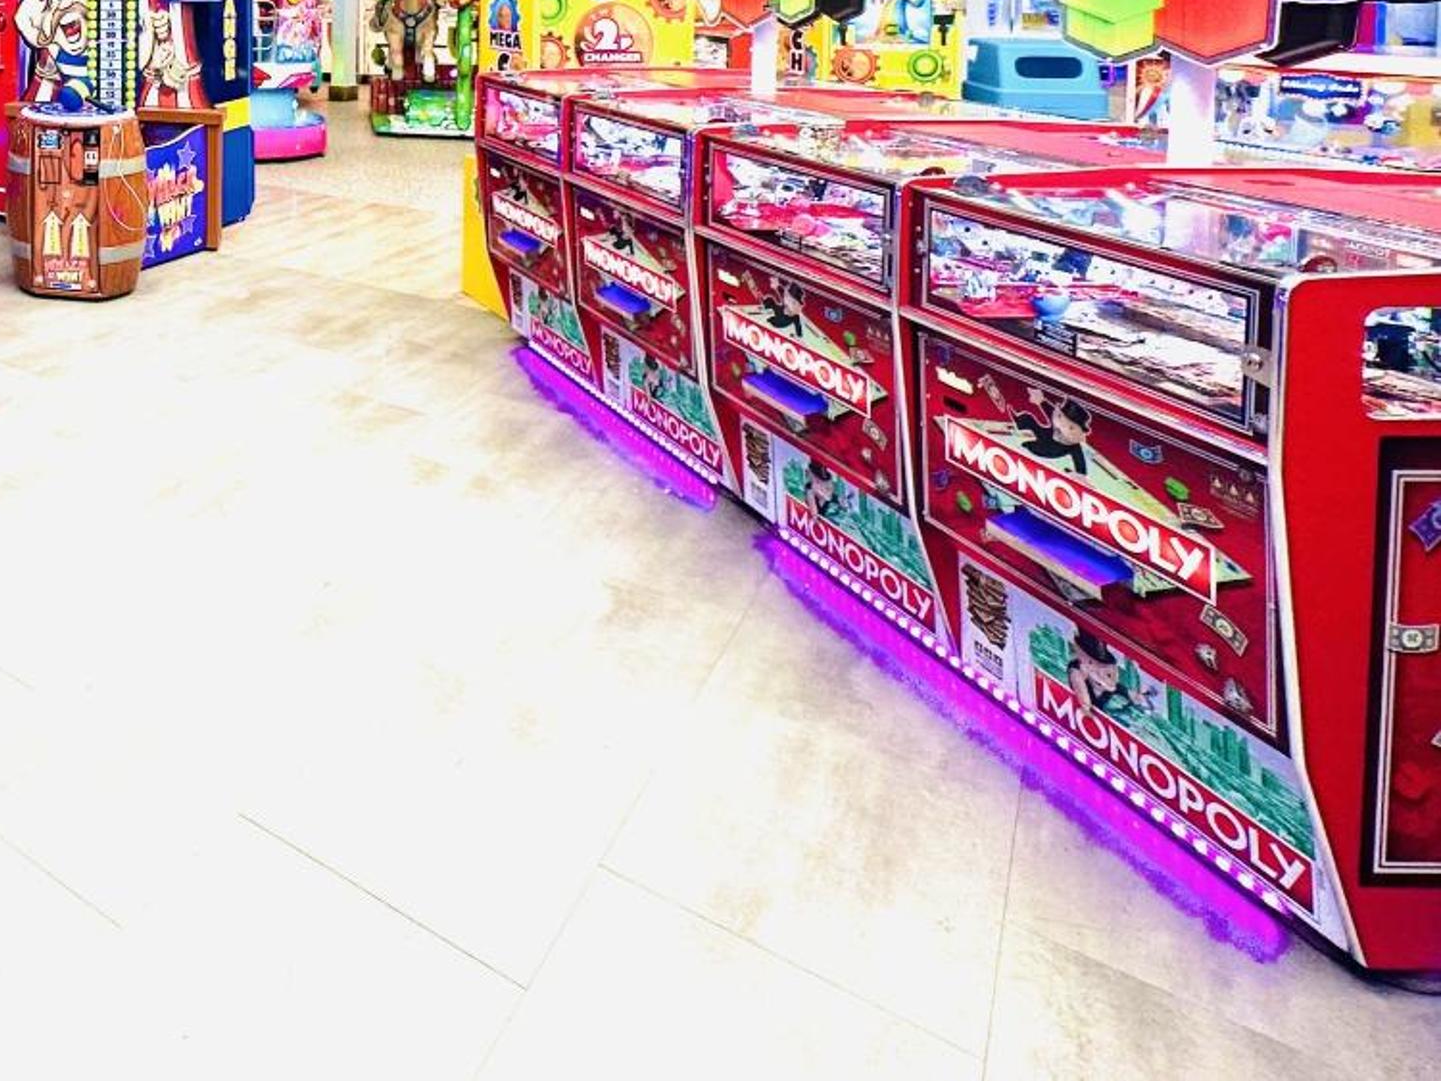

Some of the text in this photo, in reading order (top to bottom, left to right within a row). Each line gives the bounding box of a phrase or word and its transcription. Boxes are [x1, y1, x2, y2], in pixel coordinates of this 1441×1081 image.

[489, 31, 521, 50] MEGA
[583, 52, 643, 63] CHANGER
[585, 241, 673, 304] MONOPOLY
[532, 324, 592, 376] MONOPOLY
[726, 317, 867, 406] MONOPOLY
[633, 394, 720, 469] MONOPOLY
[948, 423, 1205, 581] MONOPOLY
[790, 507, 934, 621] MONOPOLY
[1042, 682, 1307, 891] MONOPOLY
